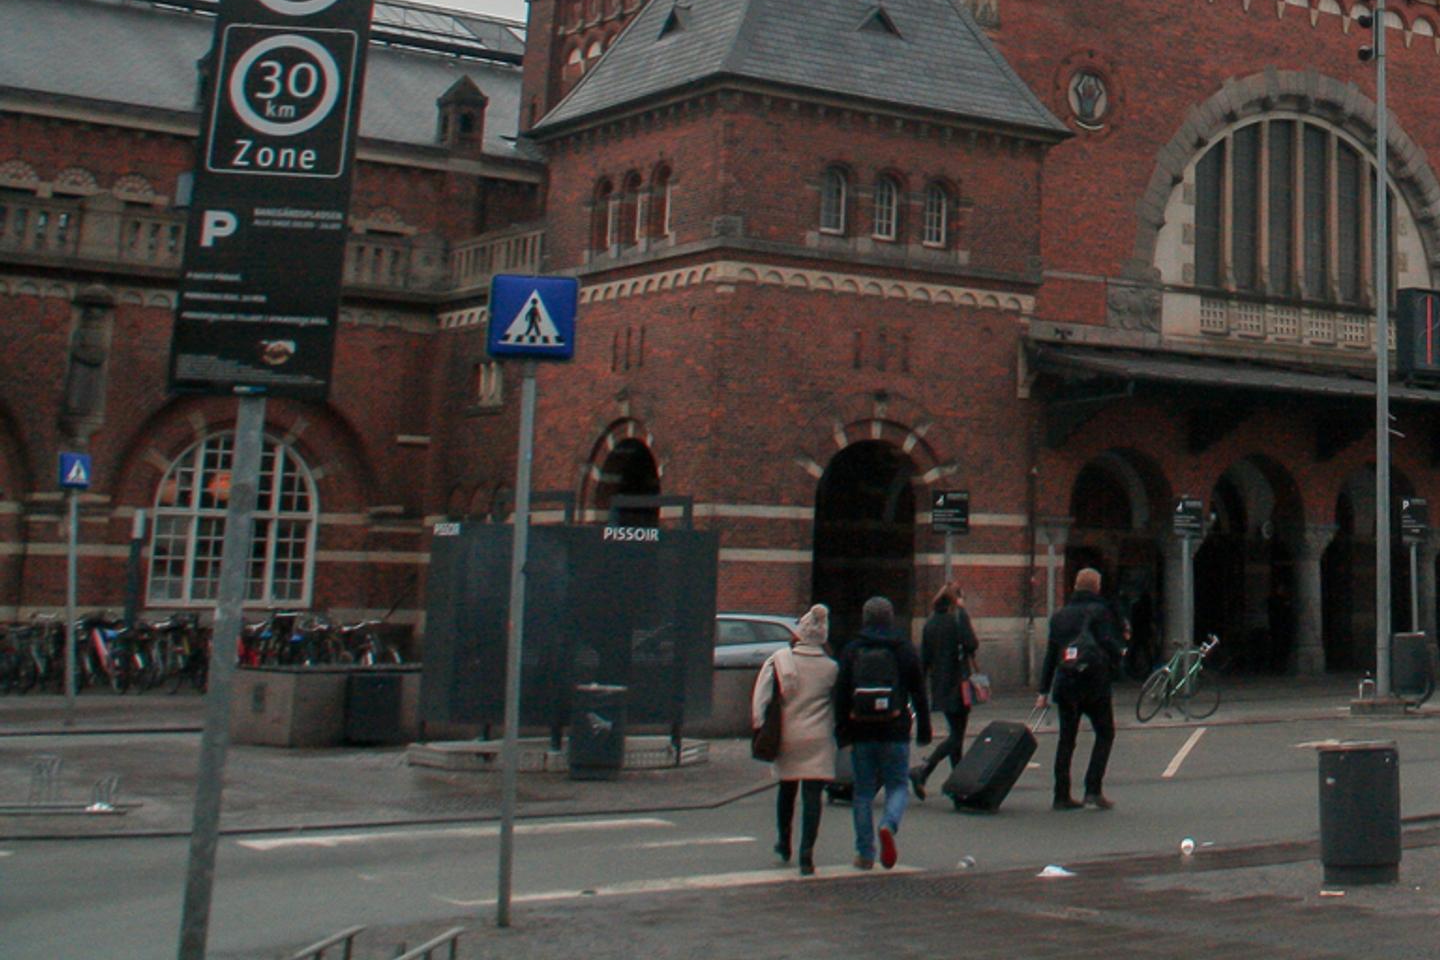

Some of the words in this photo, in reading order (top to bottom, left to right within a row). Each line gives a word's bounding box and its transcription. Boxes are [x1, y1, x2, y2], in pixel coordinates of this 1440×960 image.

[255, 60, 319, 99] 30
[265, 100, 296, 118] km
[231, 139, 317, 170] Zone
[201, 209, 238, 247] P
[603, 526, 660, 542] PISSOIR
